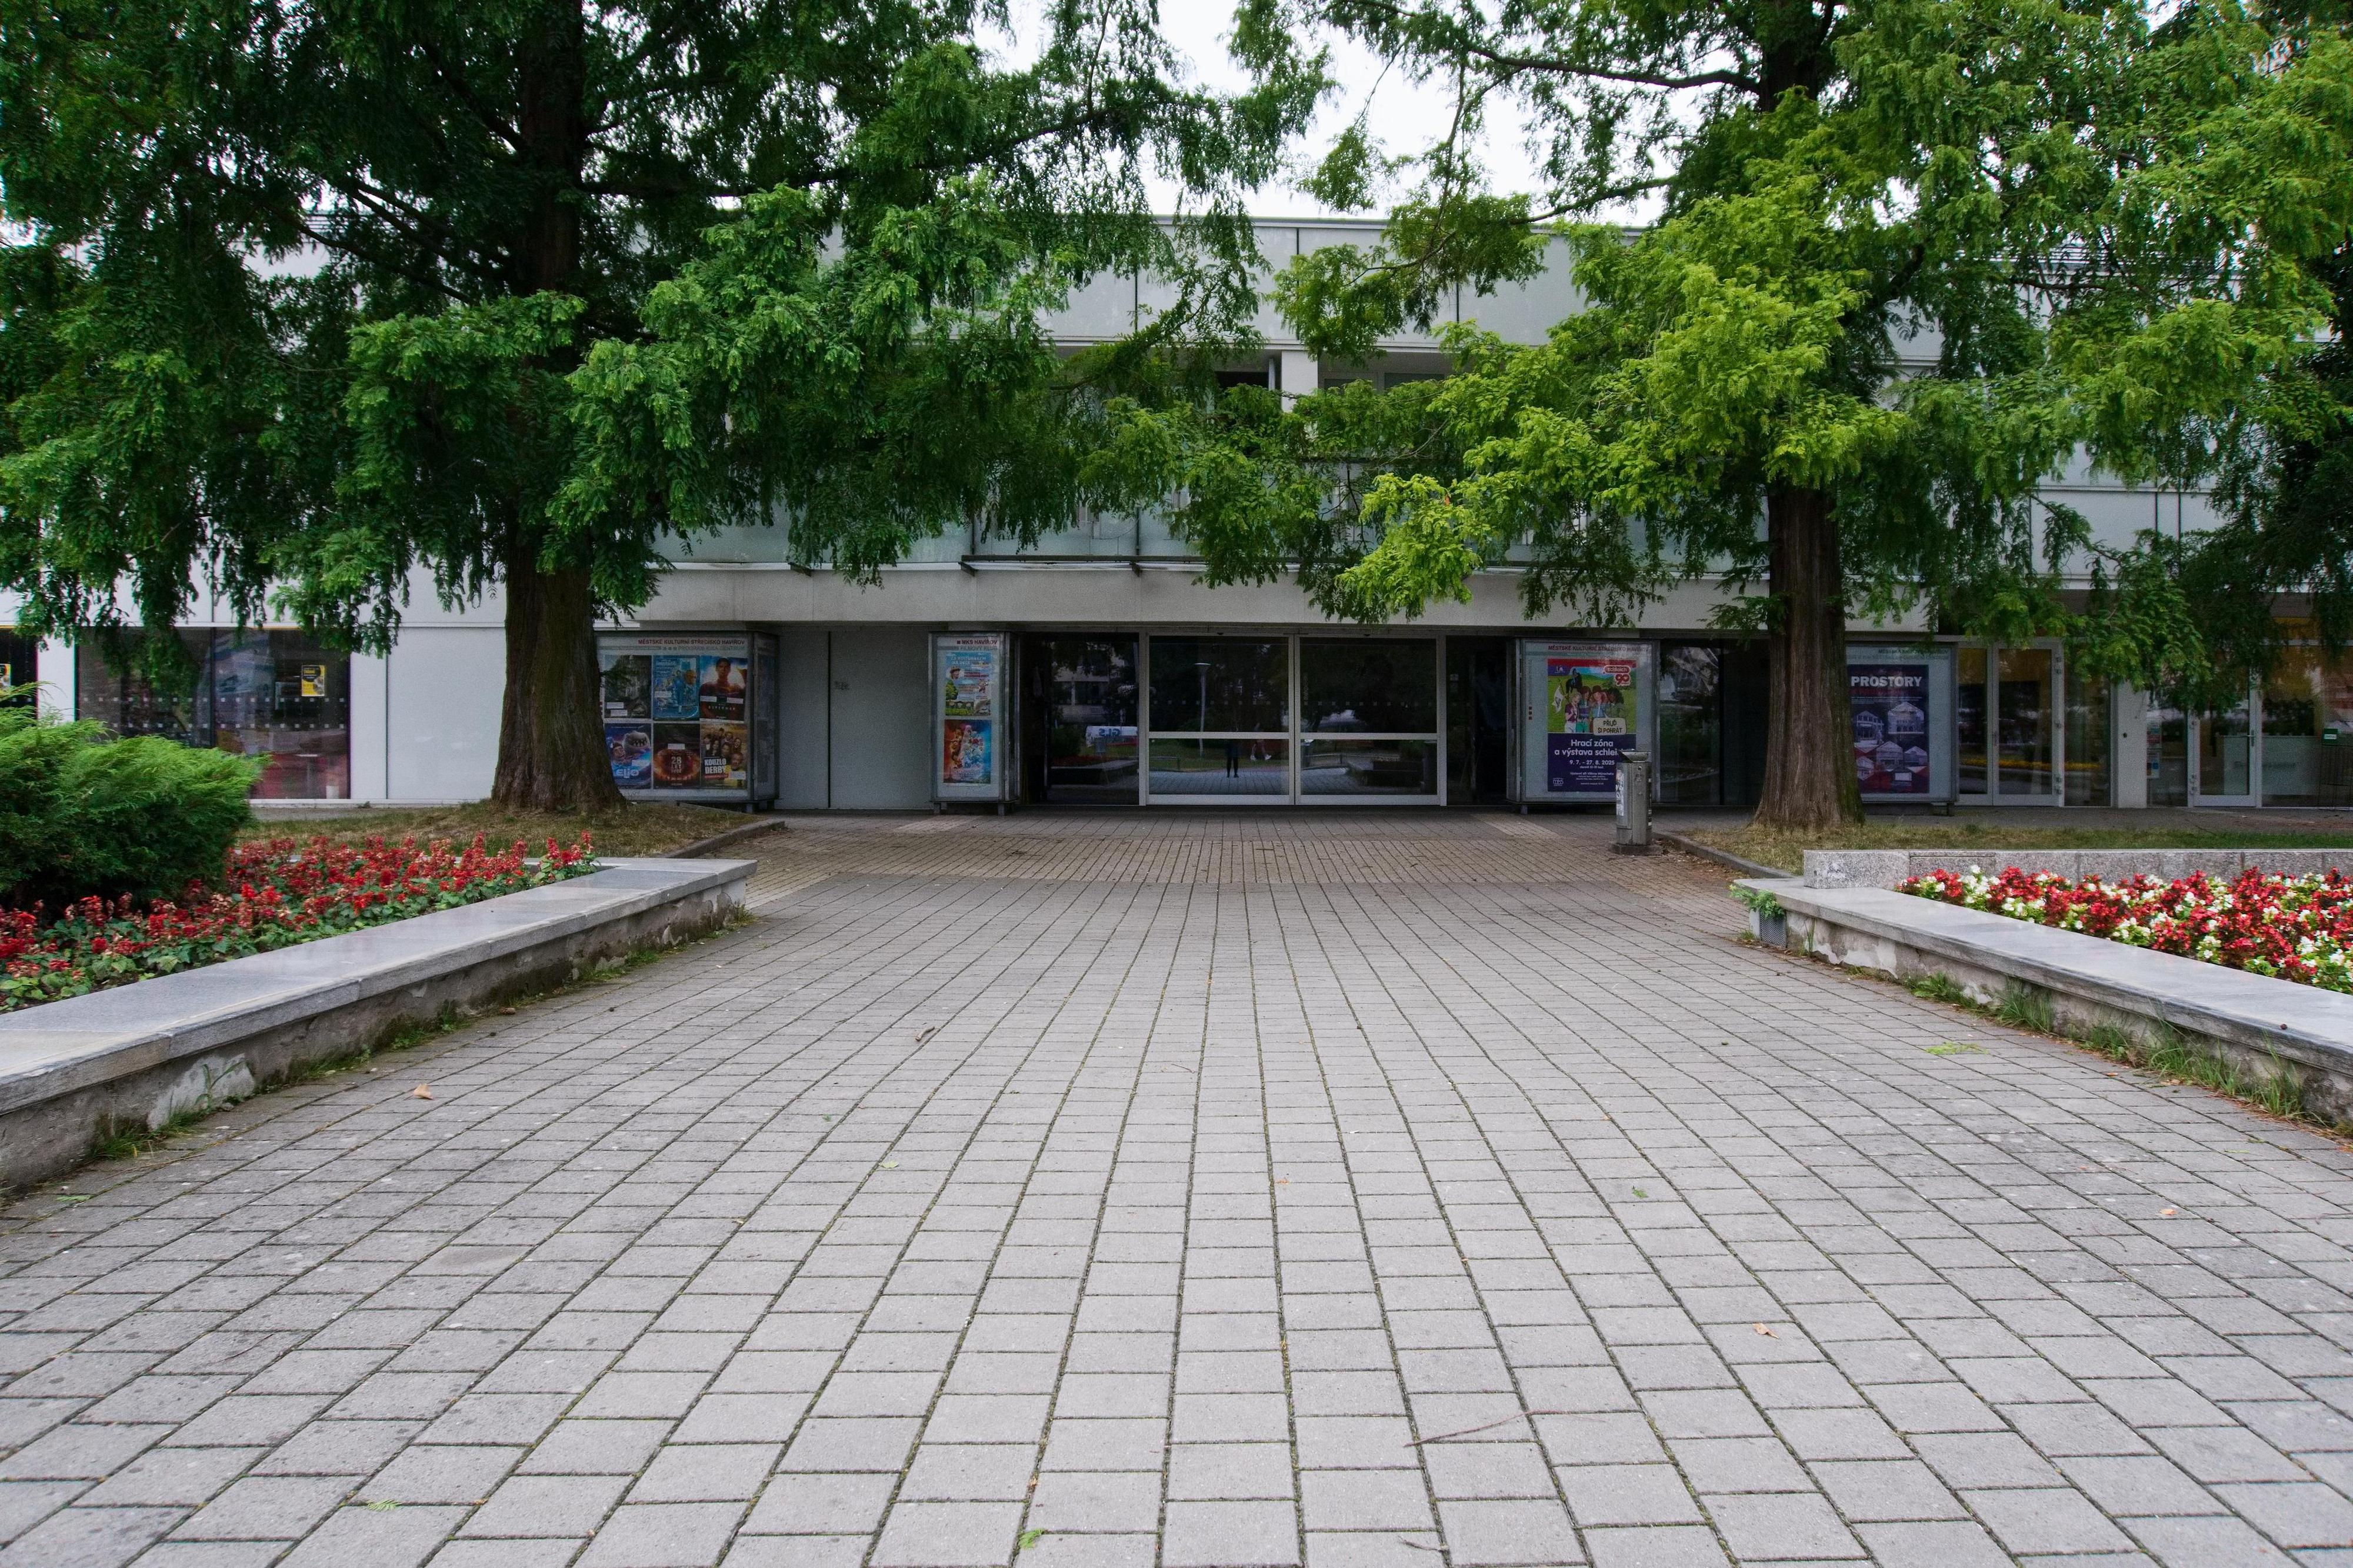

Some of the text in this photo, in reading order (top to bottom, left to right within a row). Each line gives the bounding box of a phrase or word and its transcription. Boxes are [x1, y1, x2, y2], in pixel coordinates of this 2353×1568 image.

[1851, 676, 1922, 687] PROSTORY
[1571, 739, 1593, 747] Hrací
[1562, 748, 1593, 758] výstava
[671, 756, 682, 765] 28
